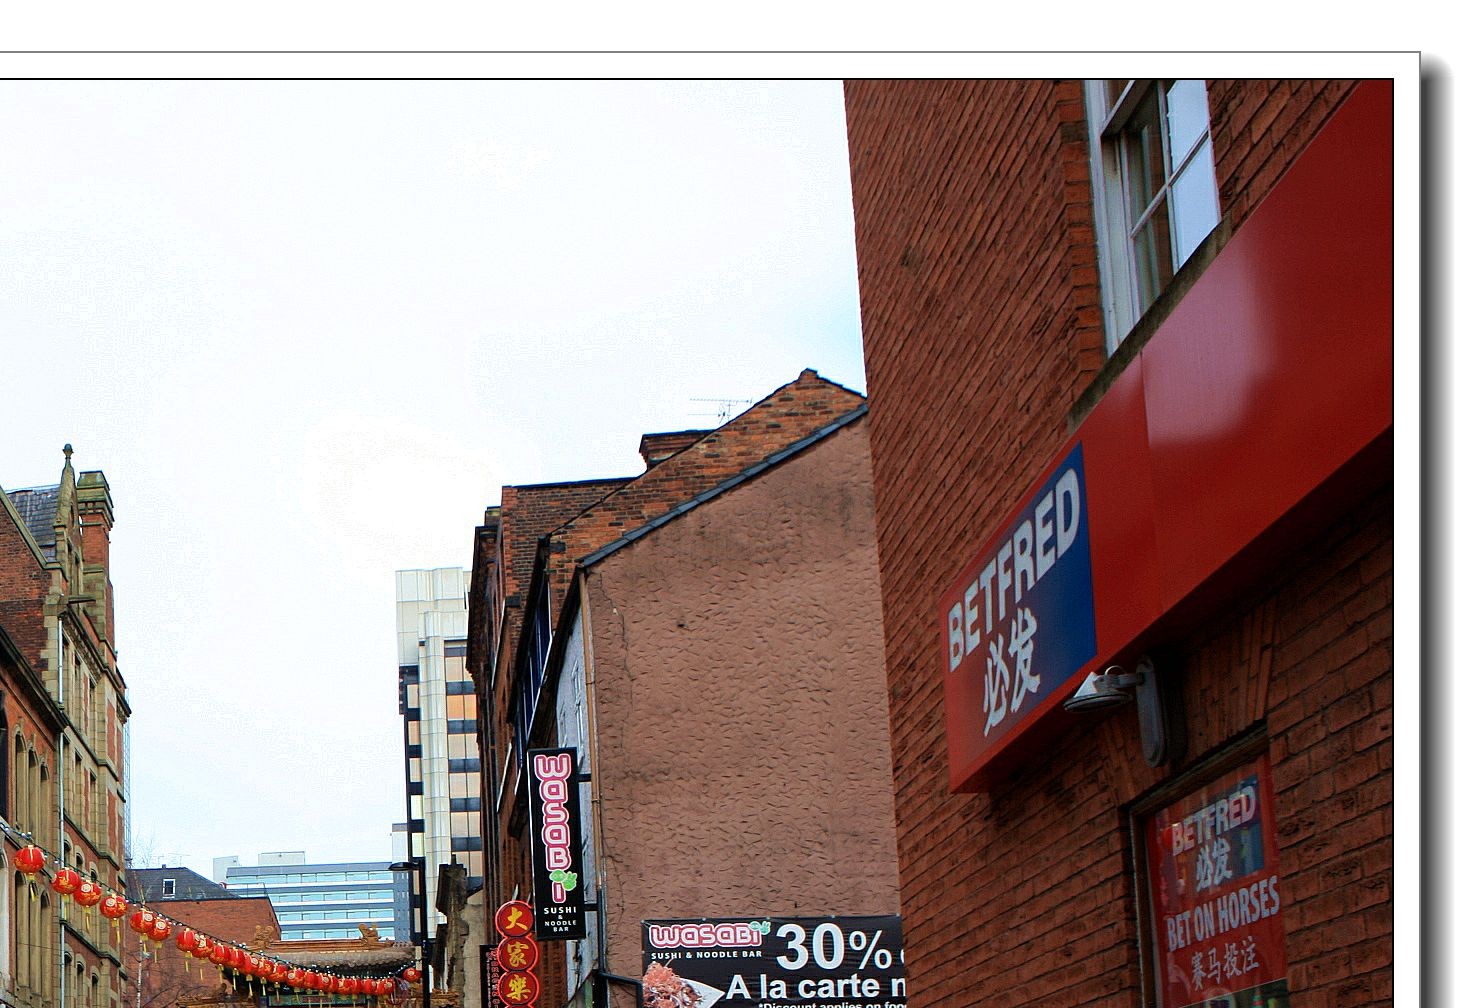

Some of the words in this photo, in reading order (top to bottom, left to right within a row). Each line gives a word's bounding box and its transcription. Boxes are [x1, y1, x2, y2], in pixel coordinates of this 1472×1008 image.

[948, 468, 1080, 673] BETFRED
[982, 607, 1040, 737] 必发
[1171, 785, 1257, 857] BETFRED
[1196, 837, 1232, 892] 必发
[1166, 910, 1192, 952] BET
[1194, 901, 1216, 943] ON
[1217, 875, 1280, 934] HORSES
[505, 906, 531, 1000] 大家樂
[651, 951, 682, 960] SUSHI
[696, 950, 739, 959] NOODLE
[742, 950, 762, 958] BAR
[726, 975, 752, 999] A
[760, 974, 786, 999] la
[798, 973, 881, 999] carte
[1191, 935, 1260, 991] 赛马投注
